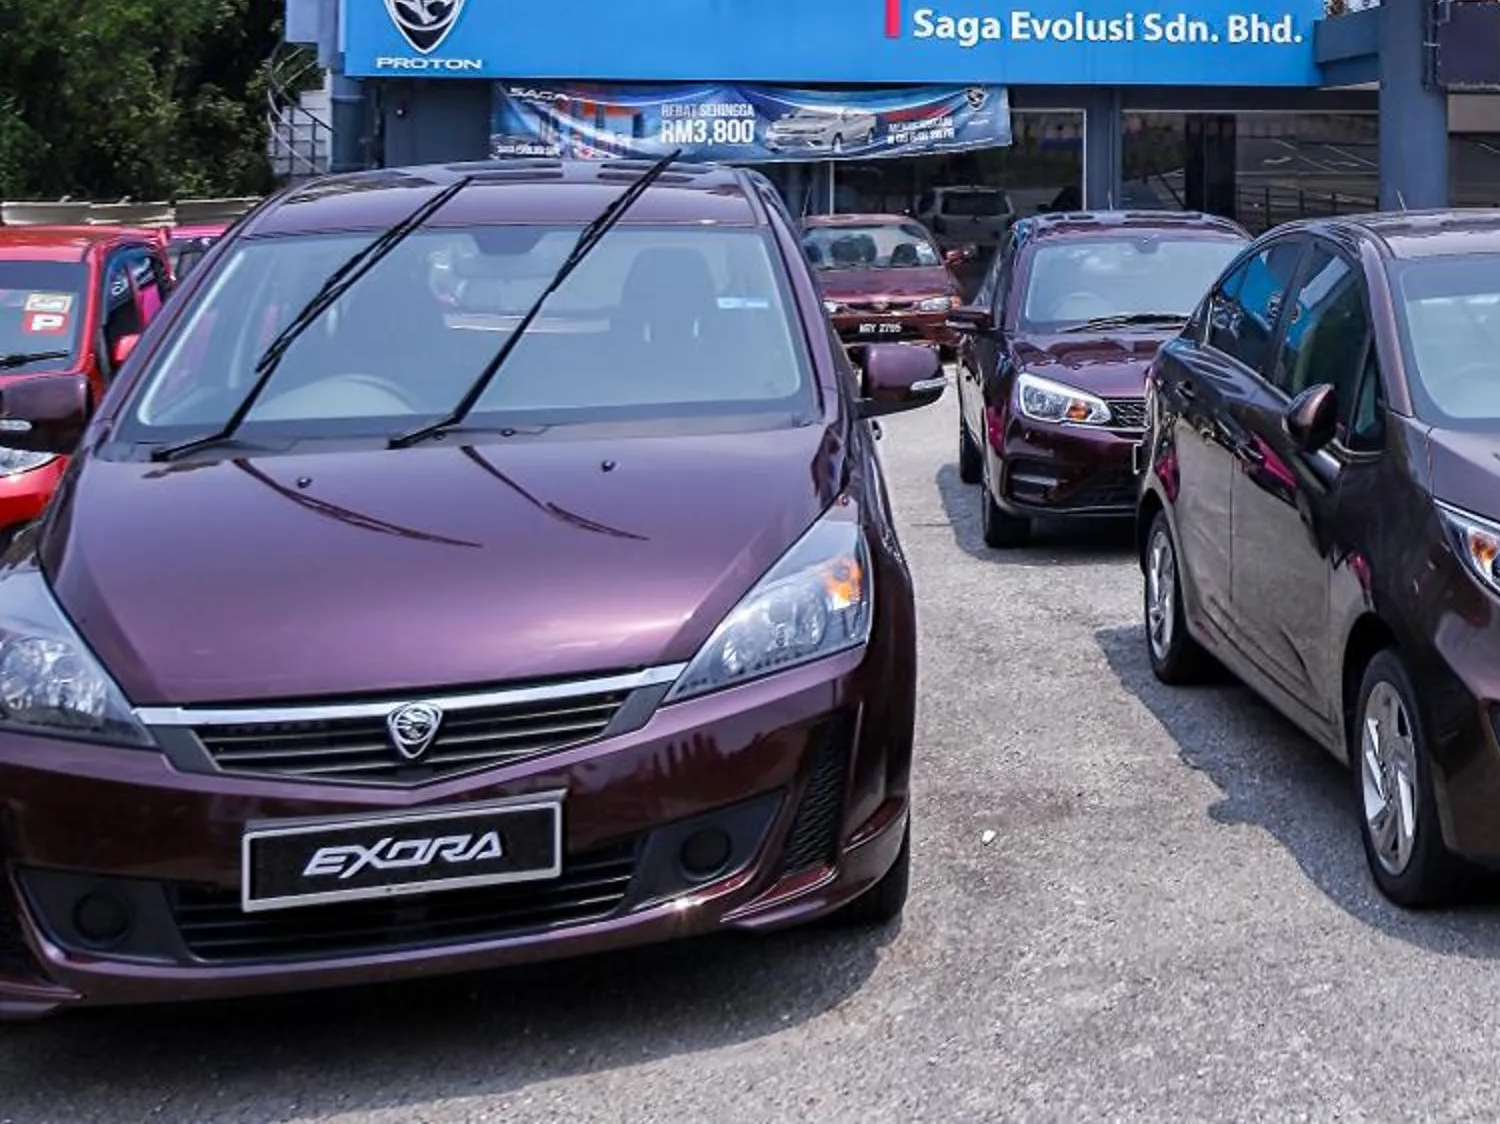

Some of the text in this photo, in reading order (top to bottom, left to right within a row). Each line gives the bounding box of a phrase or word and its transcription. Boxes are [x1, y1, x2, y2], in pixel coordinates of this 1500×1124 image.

[913, 8, 1302, 47] Saga Evolusi Sdn. Bhd.
[376, 57, 482, 70] PROTON
[661, 119, 755, 146] RM3,800
[32, 314, 64, 331] P
[303, 831, 502, 878] EXORA
